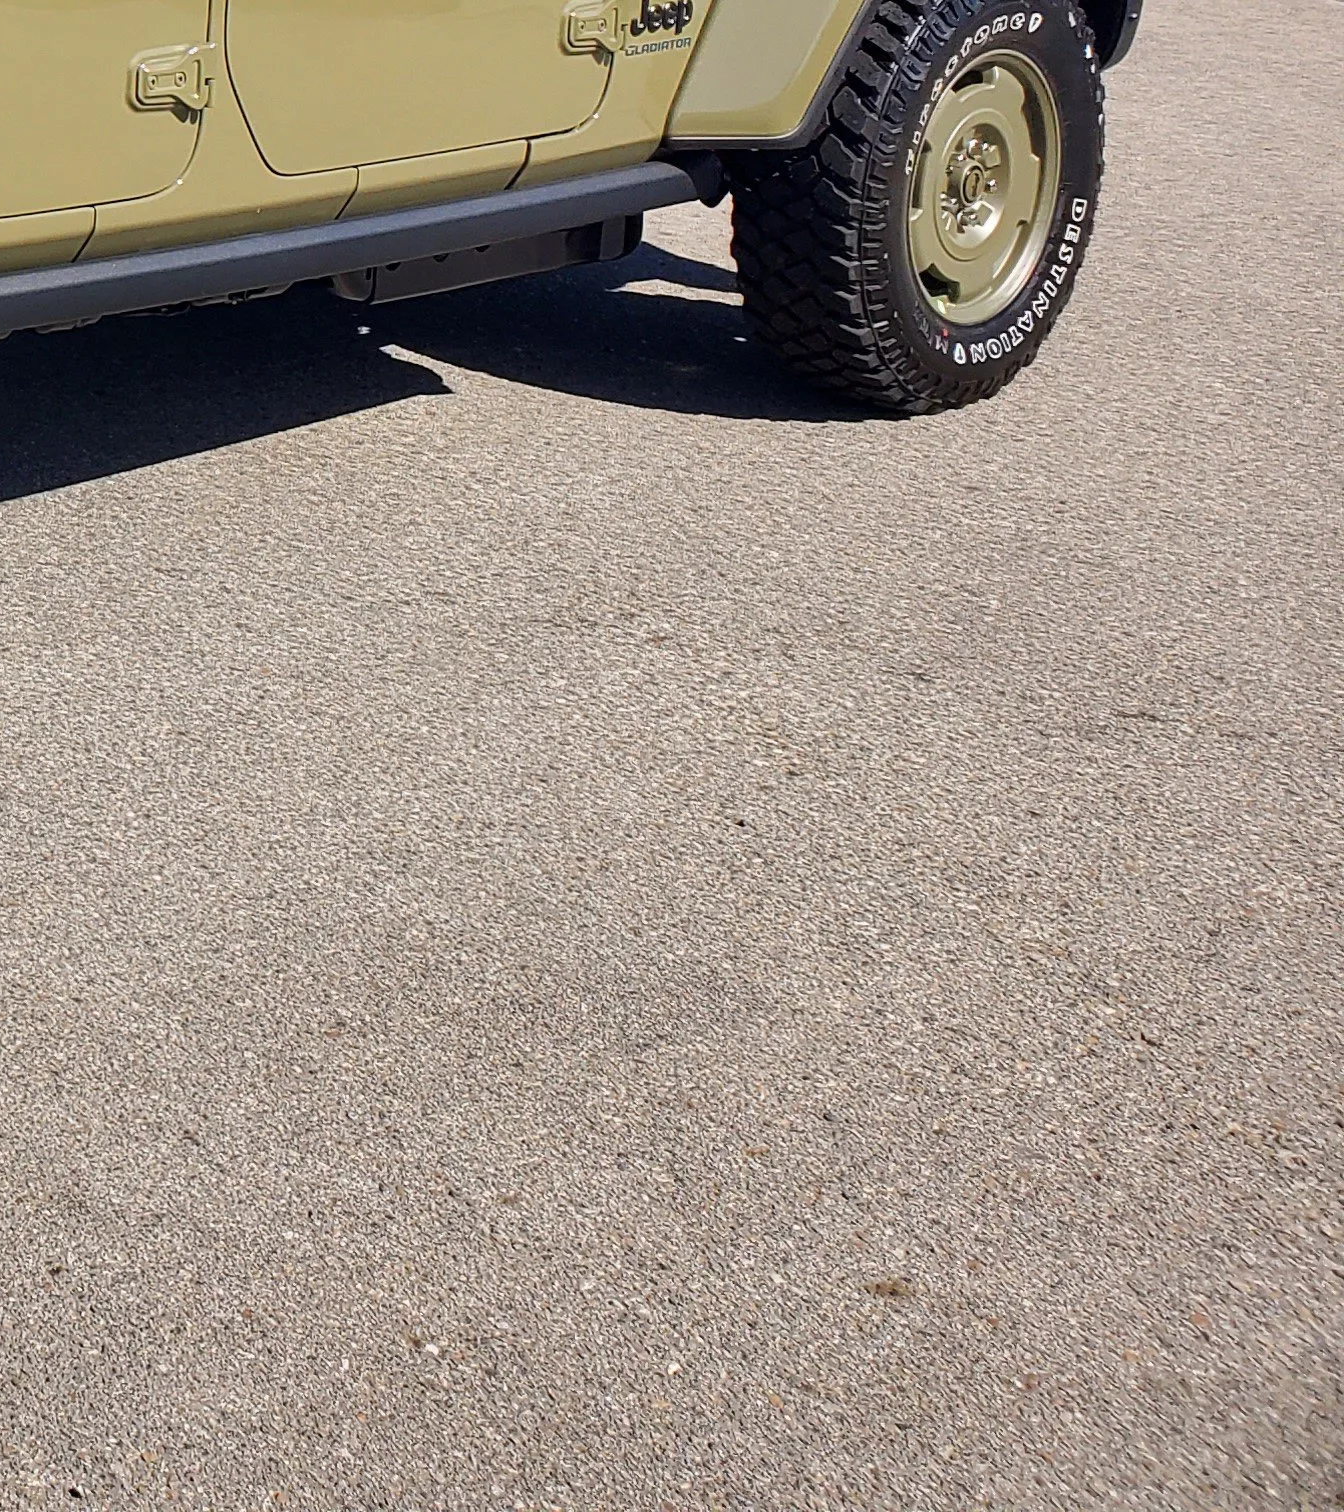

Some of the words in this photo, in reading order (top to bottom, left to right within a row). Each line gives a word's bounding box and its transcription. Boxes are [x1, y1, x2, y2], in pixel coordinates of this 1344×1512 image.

[624, 37, 692, 57] GLADIATOR
[904, 11, 1026, 176] Firestone
[969, 197, 1088, 365] DESTINATION
